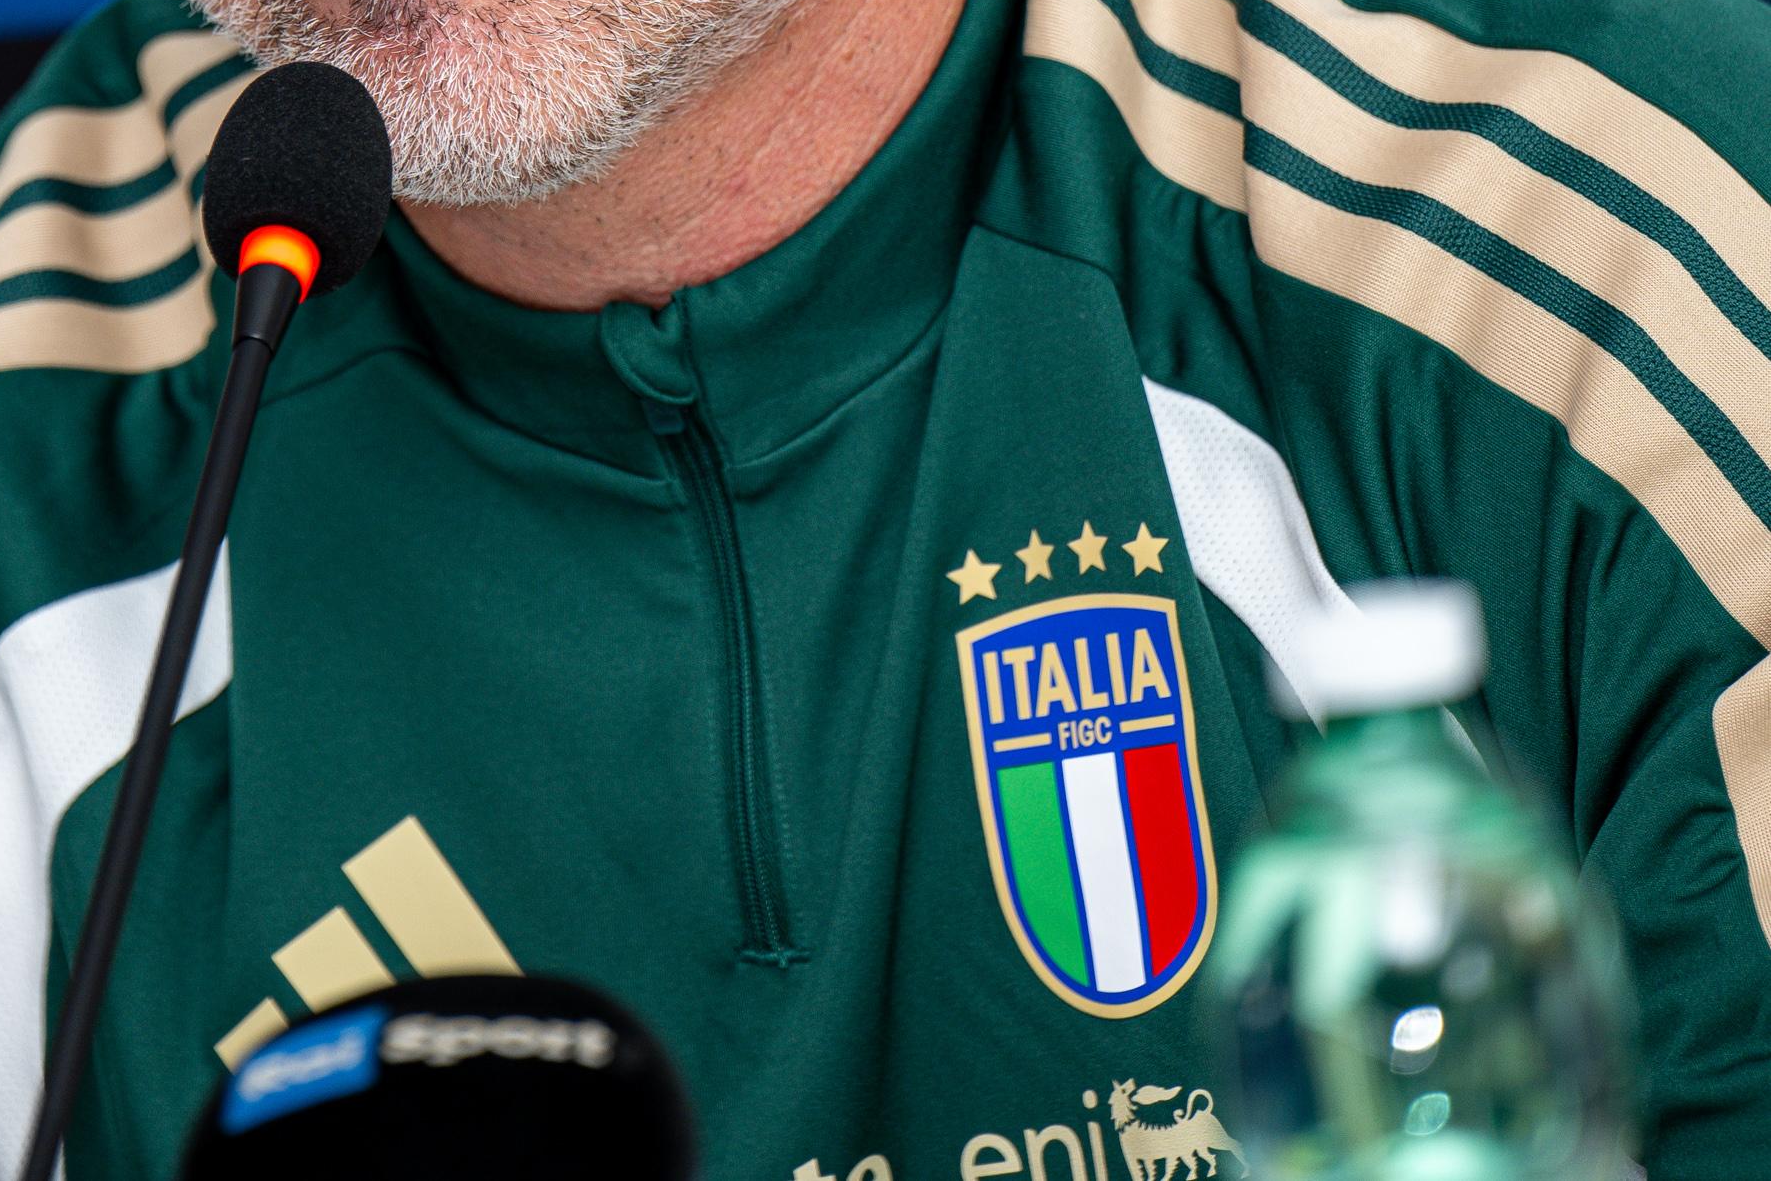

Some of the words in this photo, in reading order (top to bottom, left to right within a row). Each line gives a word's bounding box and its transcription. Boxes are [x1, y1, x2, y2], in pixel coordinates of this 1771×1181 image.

[982, 627, 1171, 725] ITALIA
[1057, 715, 1112, 751] FIGC
[378, 1014, 617, 1069] sport
[959, 1088, 1113, 1181] eni
